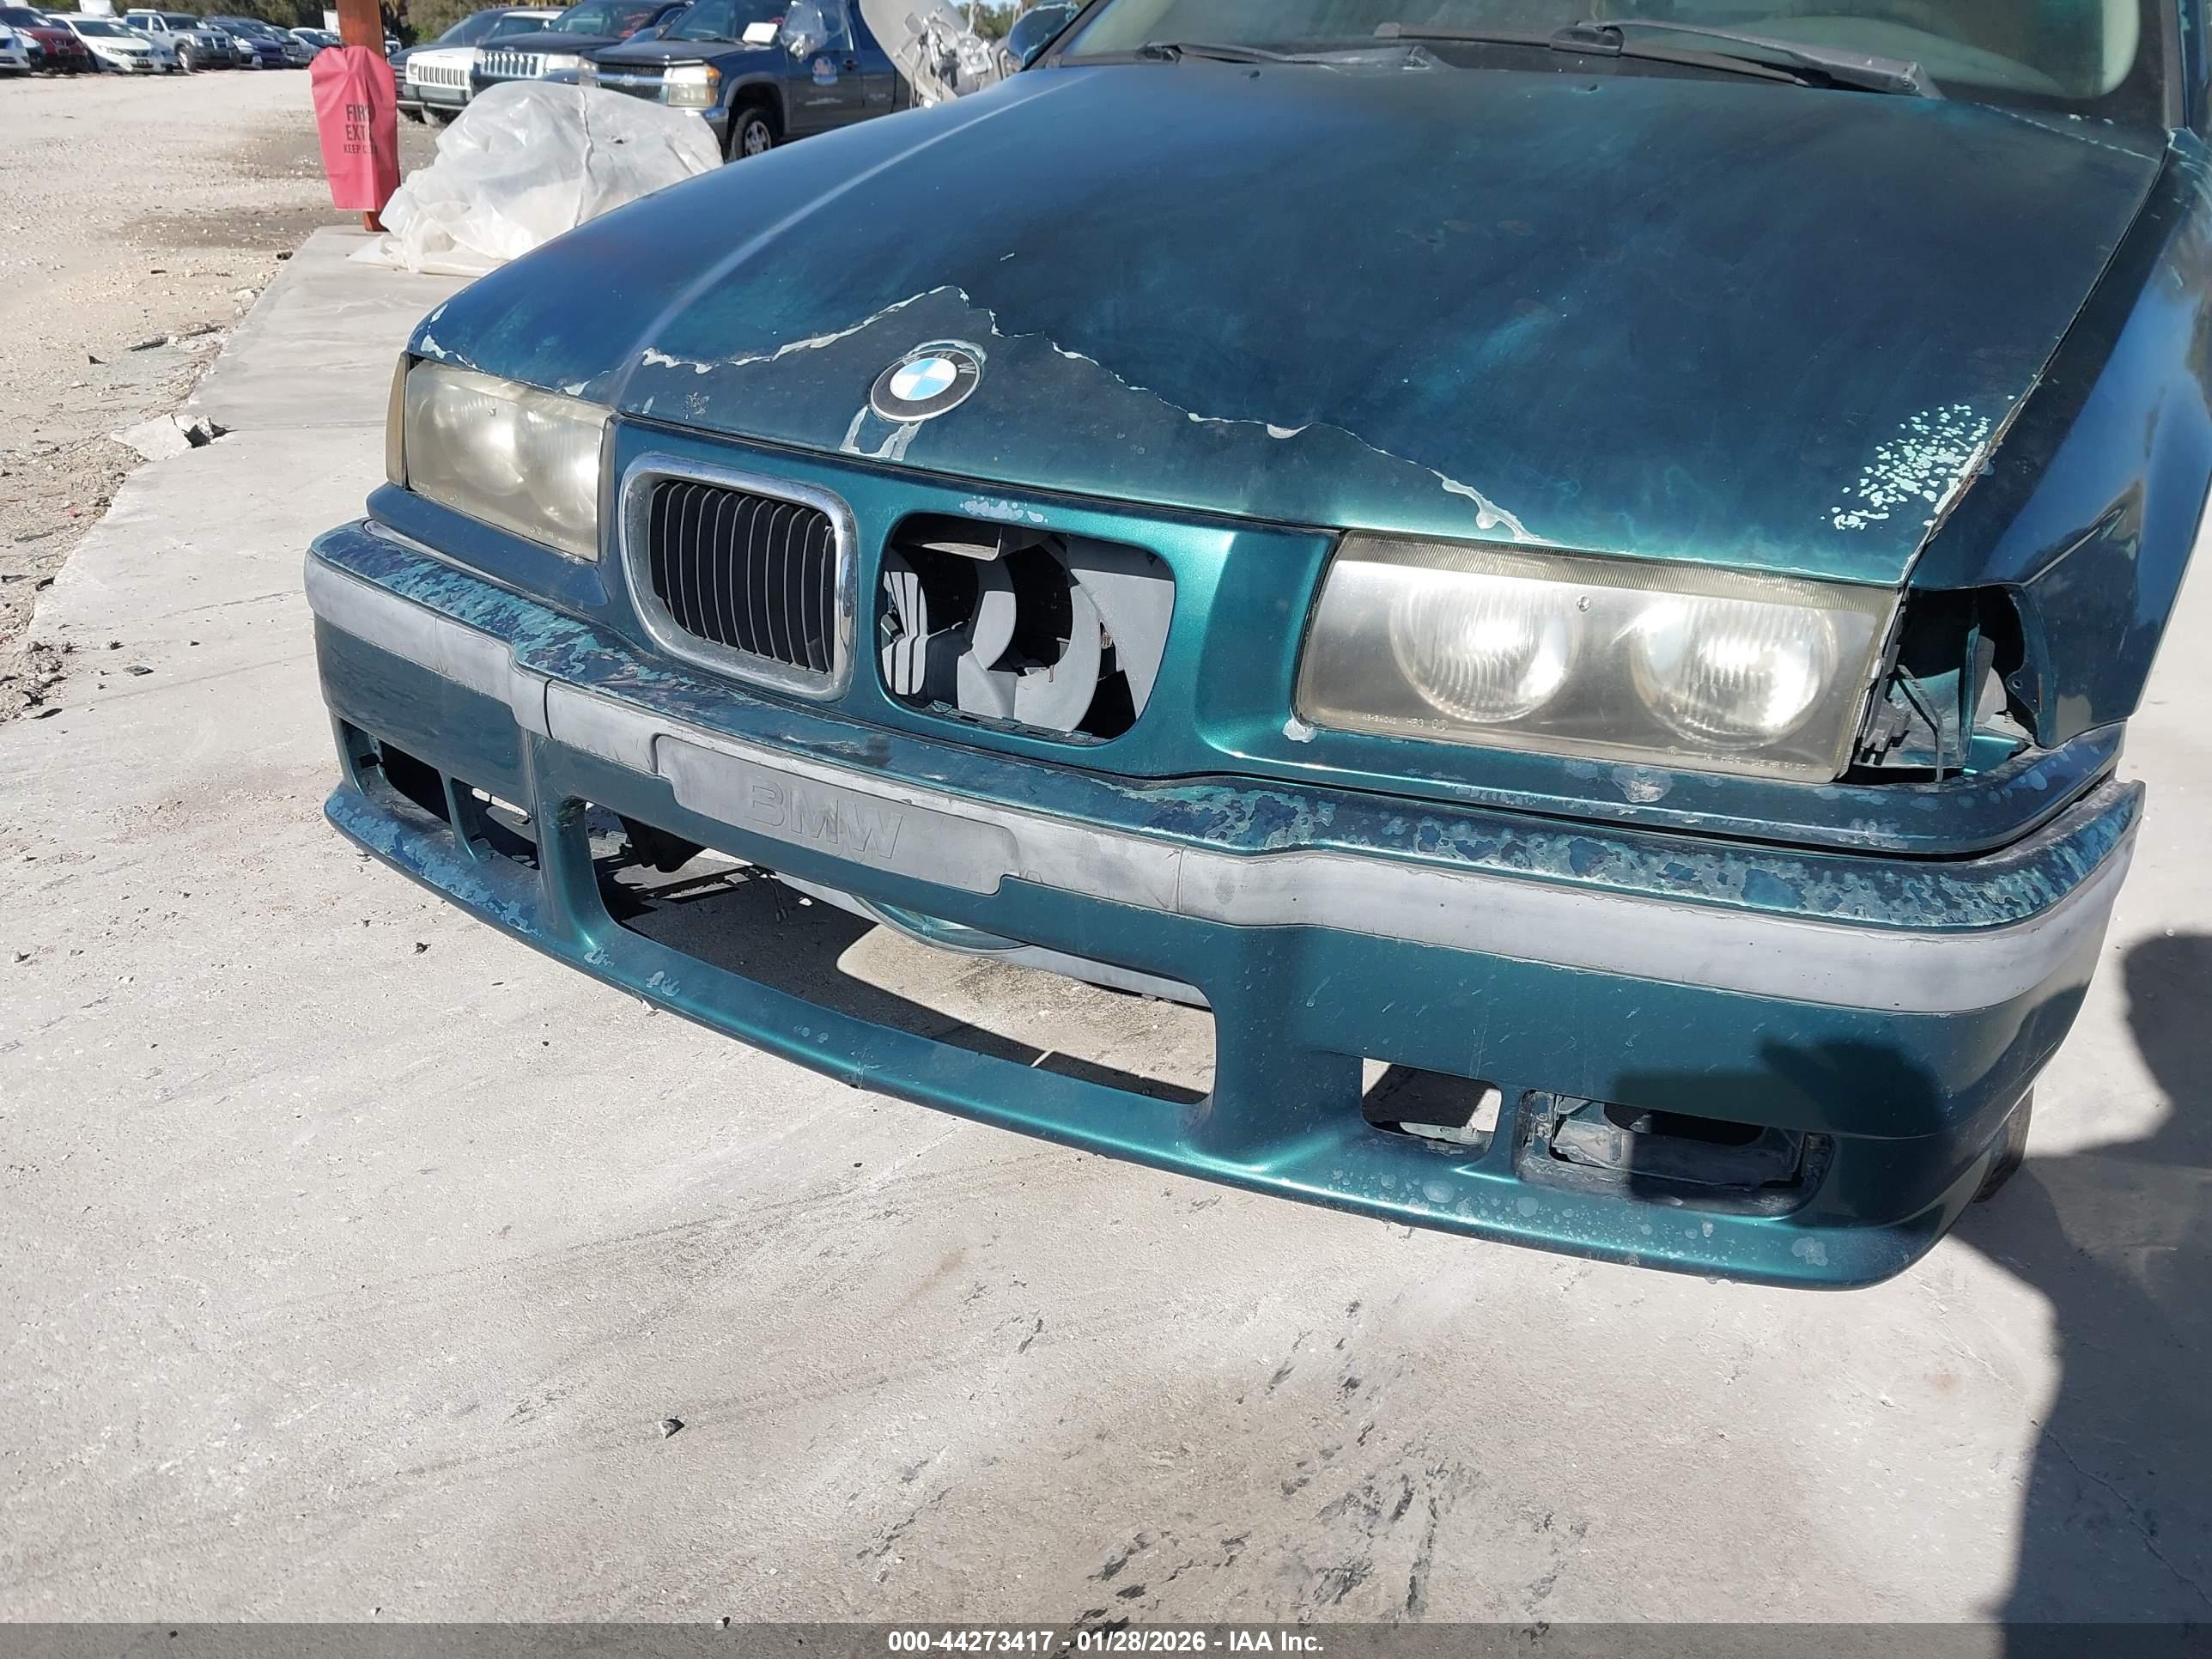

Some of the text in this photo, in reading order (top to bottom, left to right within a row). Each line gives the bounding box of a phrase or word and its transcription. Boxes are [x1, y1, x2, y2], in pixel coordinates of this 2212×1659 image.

[346, 104, 368, 121] FIR
[345, 124, 368, 141] EXT
[343, 143, 361, 154] KEEP
[745, 782, 903, 860] BMW
